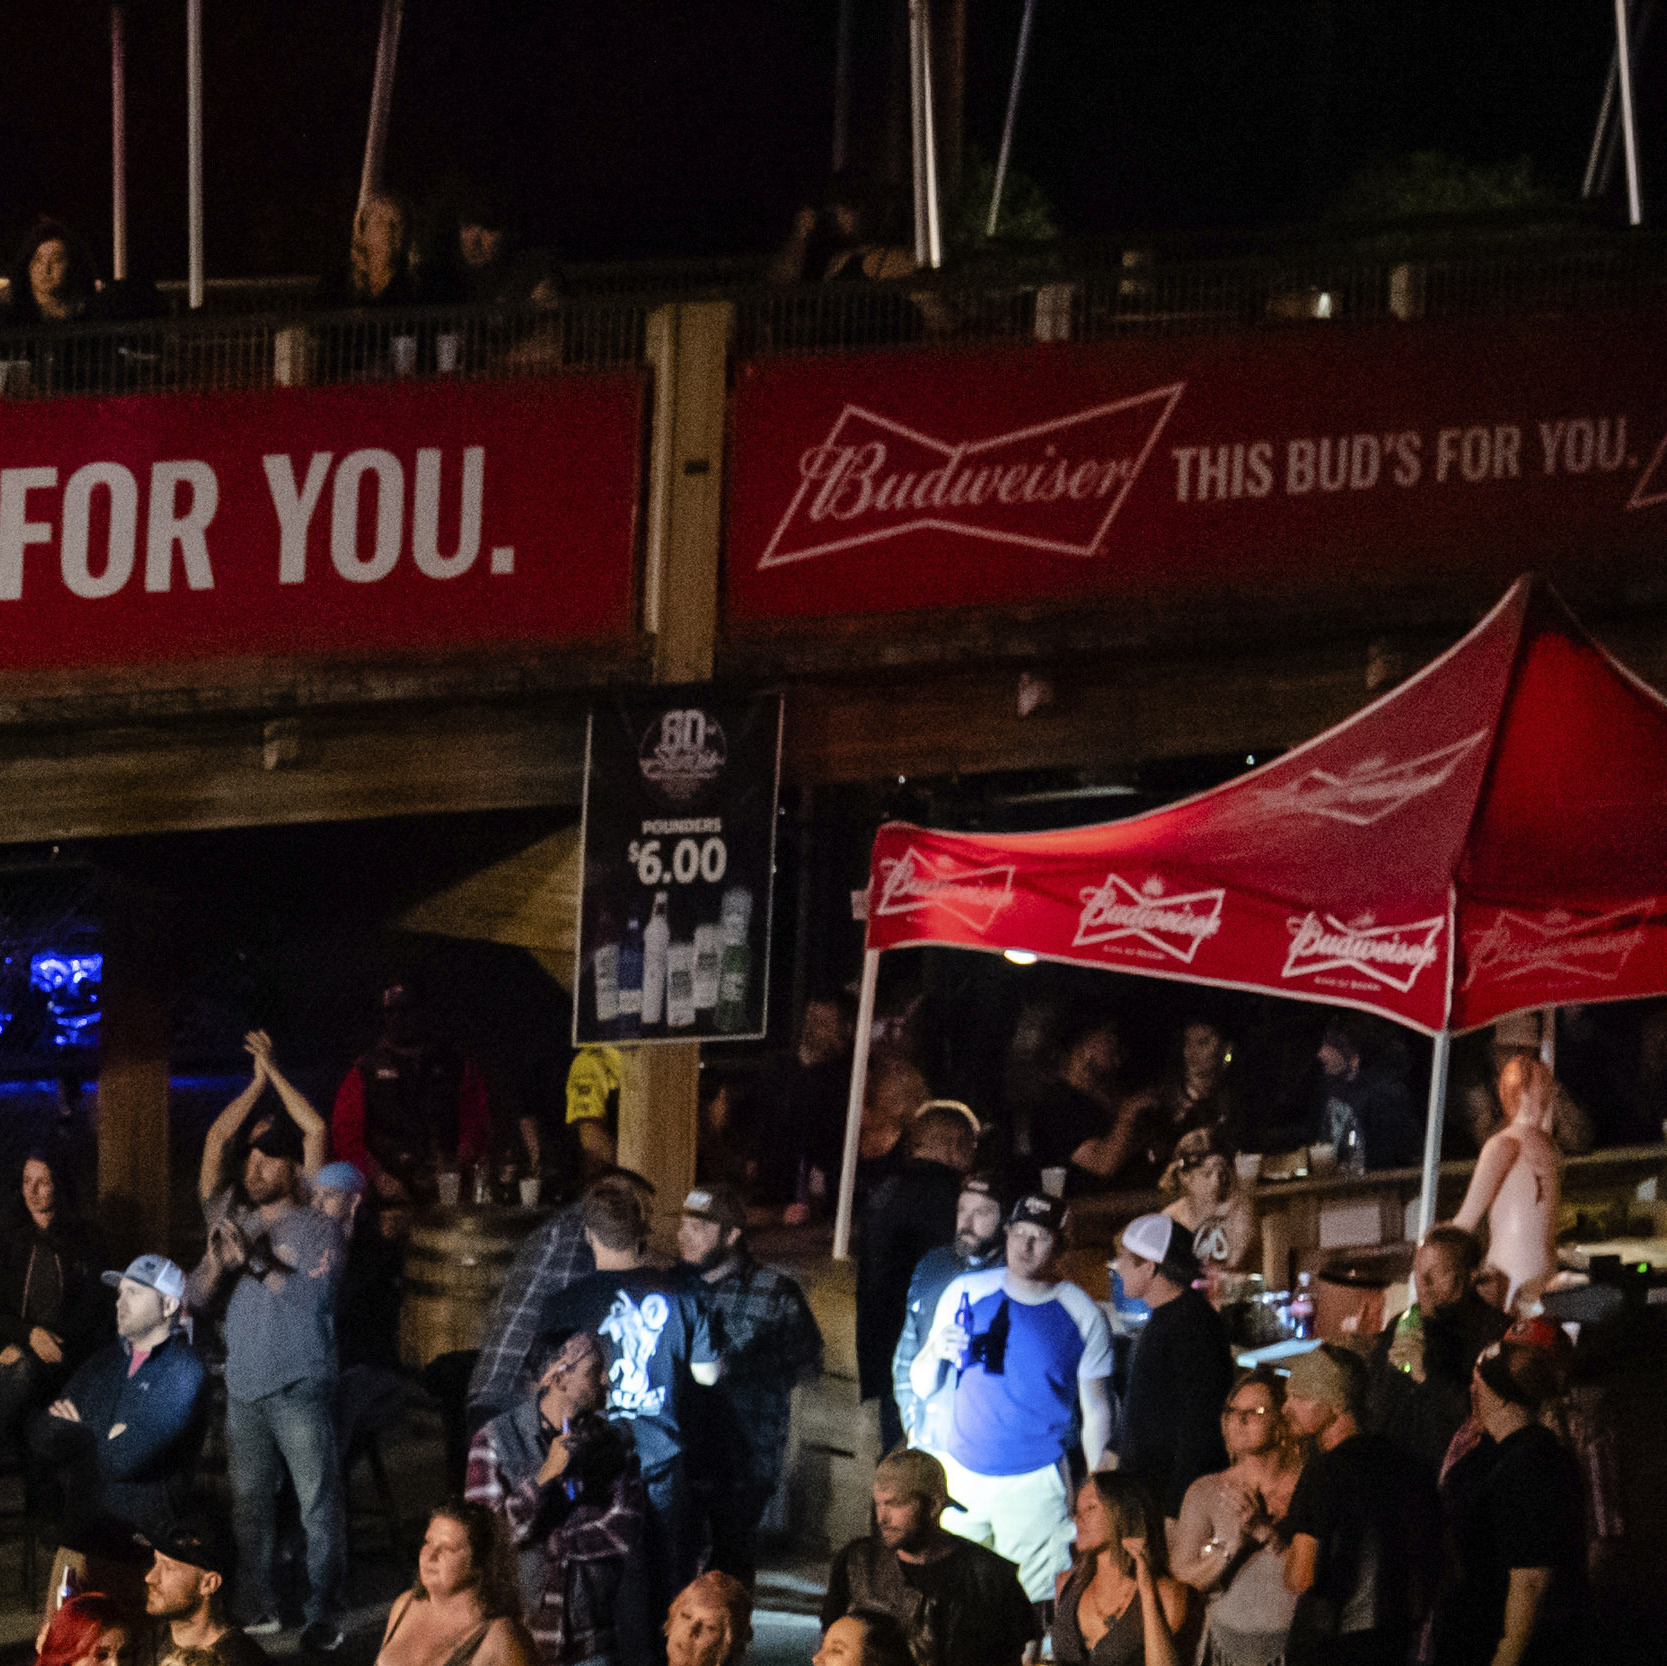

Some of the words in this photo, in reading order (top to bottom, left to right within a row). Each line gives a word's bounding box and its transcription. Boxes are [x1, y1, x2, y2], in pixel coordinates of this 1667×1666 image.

[799, 440, 1141, 521] Budweiser
[1171, 445, 1275, 503] THIS
[1436, 424, 1520, 484] FOR
[1538, 416, 1640, 476] YOU.
[262, 445, 516, 584] YOU.
[627, 837, 728, 885] $6.00
[1078, 884, 1223, 942] Budweiser
[1285, 912, 1439, 966] Budweiser
